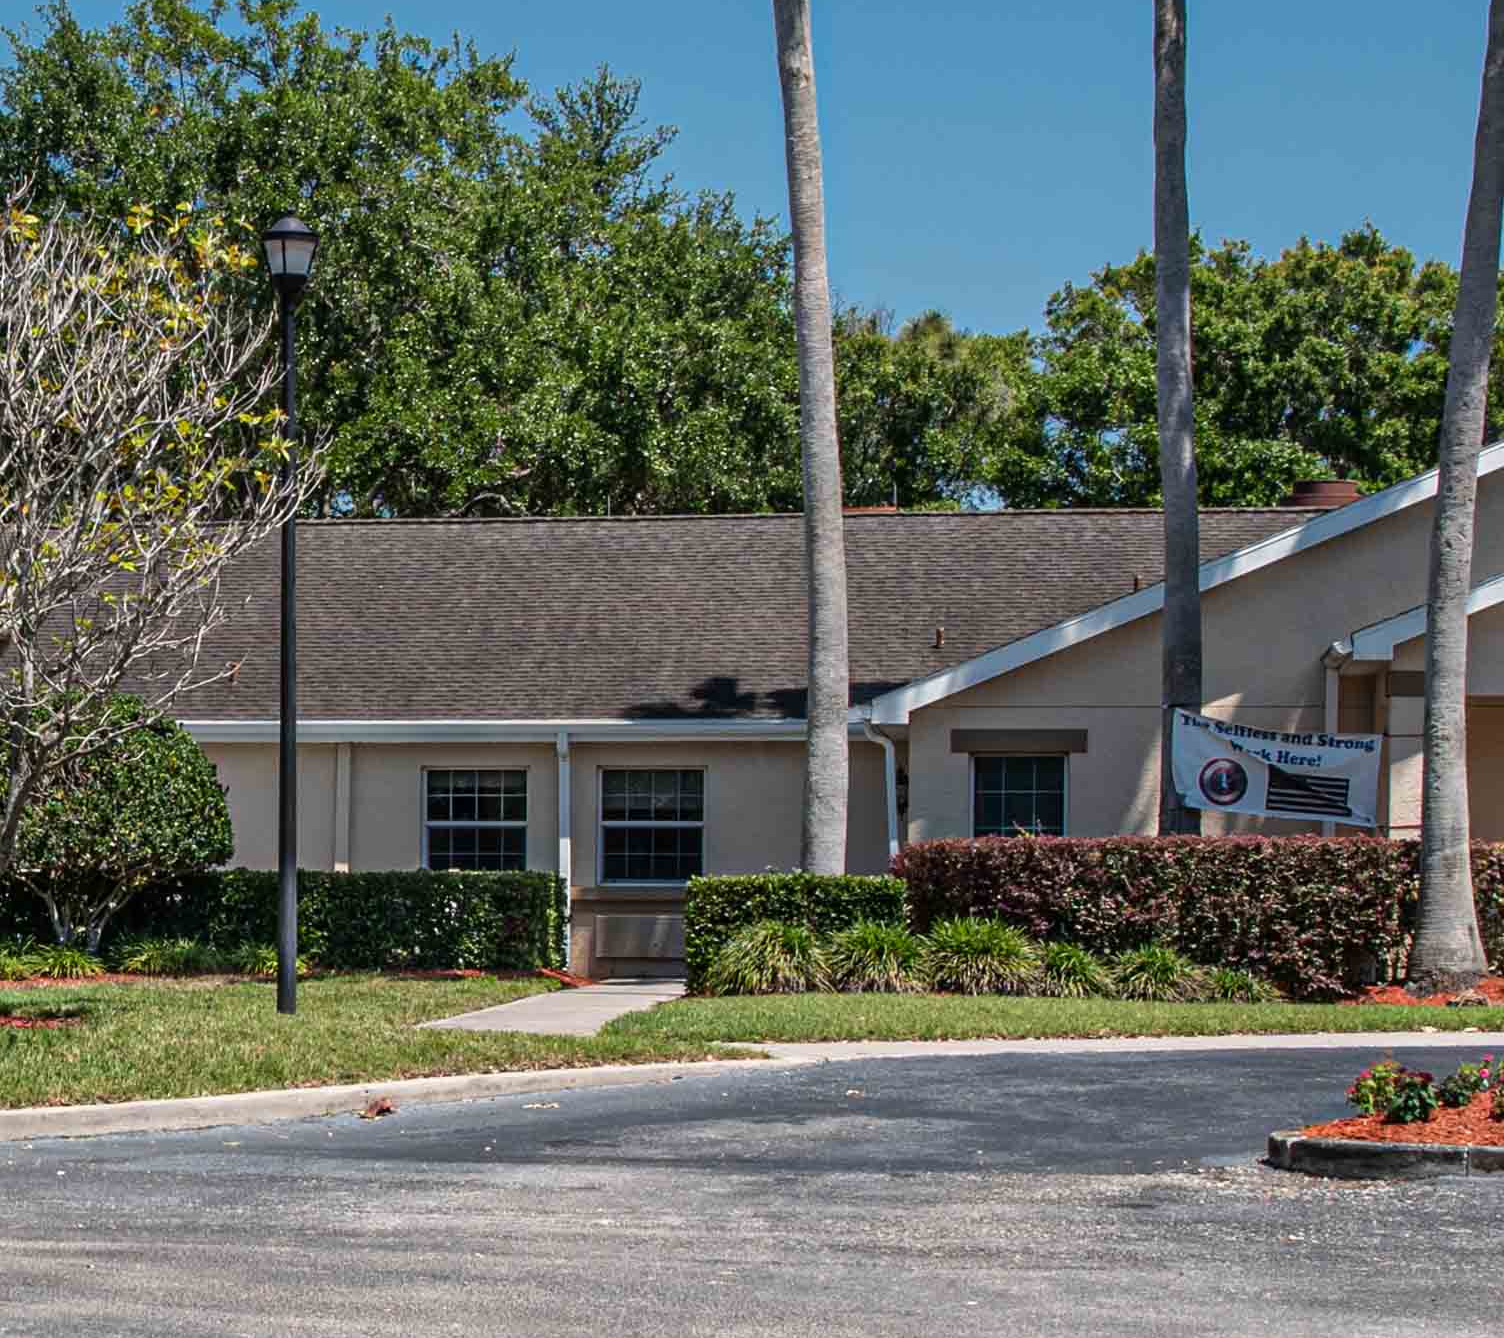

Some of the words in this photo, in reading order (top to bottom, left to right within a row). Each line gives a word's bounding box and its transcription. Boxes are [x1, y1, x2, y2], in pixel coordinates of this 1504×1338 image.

[1281, 731, 1313, 746] and
[1316, 733, 1376, 752] Strong
[1277, 750, 1322, 767] Here!
